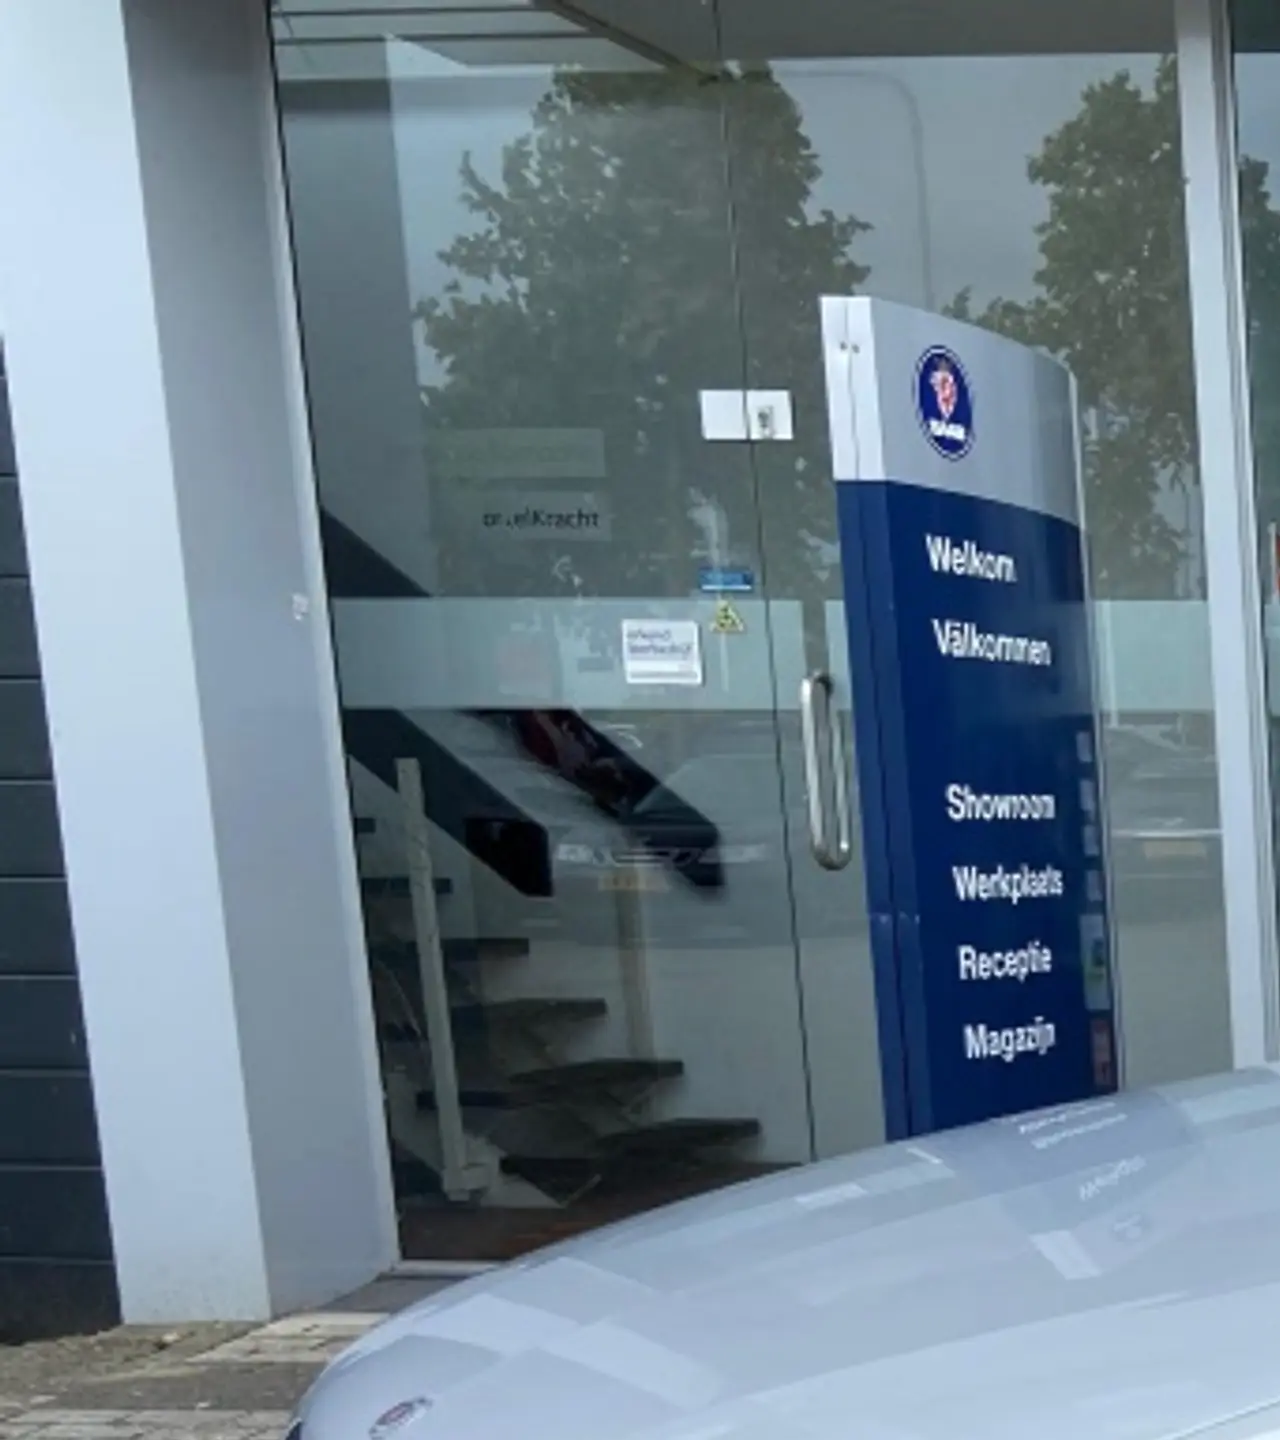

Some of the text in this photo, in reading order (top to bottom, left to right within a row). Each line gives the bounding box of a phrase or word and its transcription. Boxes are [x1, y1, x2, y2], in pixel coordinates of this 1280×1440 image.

[925, 534, 1017, 582] Welkom
[932, 618, 1052, 665] Välkommen
[945, 784, 1055, 821] Showroom
[952, 865, 1063, 903] Werkplaats
[957, 941, 1052, 982] Receptie
[963, 1016, 1055, 1061] Magazijn
